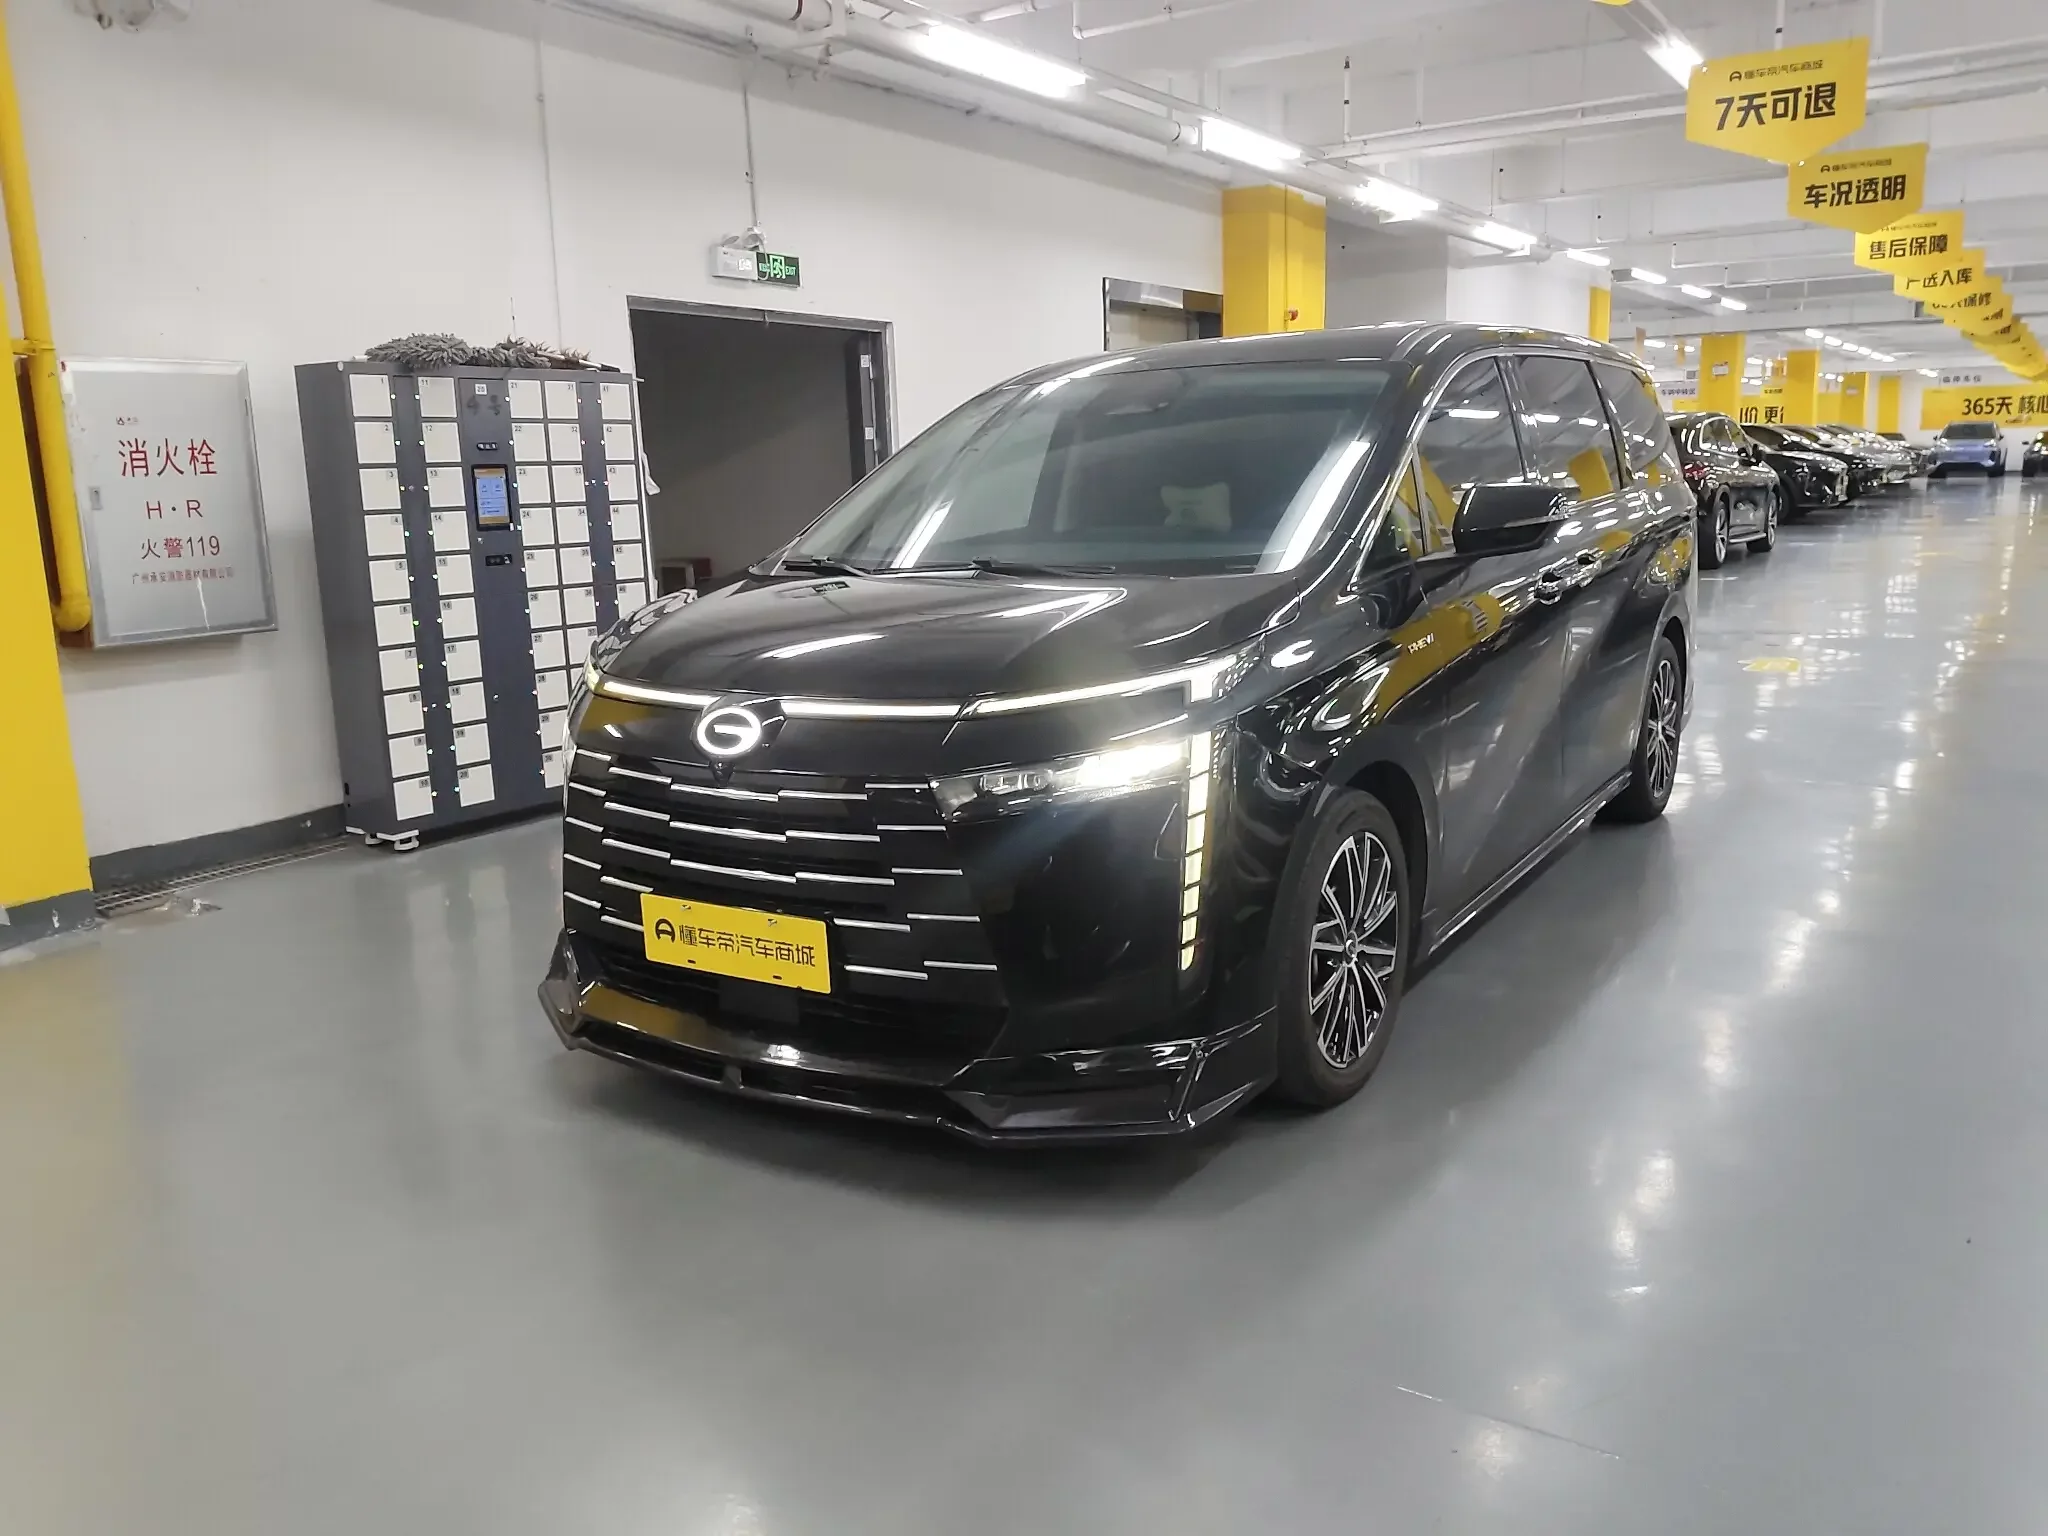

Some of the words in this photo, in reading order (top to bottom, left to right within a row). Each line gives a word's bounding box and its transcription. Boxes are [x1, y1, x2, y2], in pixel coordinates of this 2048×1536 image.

[1715, 82, 1837, 131] 7天可退
[1804, 174, 1907, 209] 车况透明
[1869, 234, 1948, 260] 售后保障
[1739, 406, 1758, 424] 价
[1764, 406, 1784, 424] 更
[1962, 396, 2013, 416] 365天
[118, 438, 218, 477] 消火栓
[141, 535, 221, 560] 火警119
[678, 924, 816, 967] 懂车帝汽车商城
